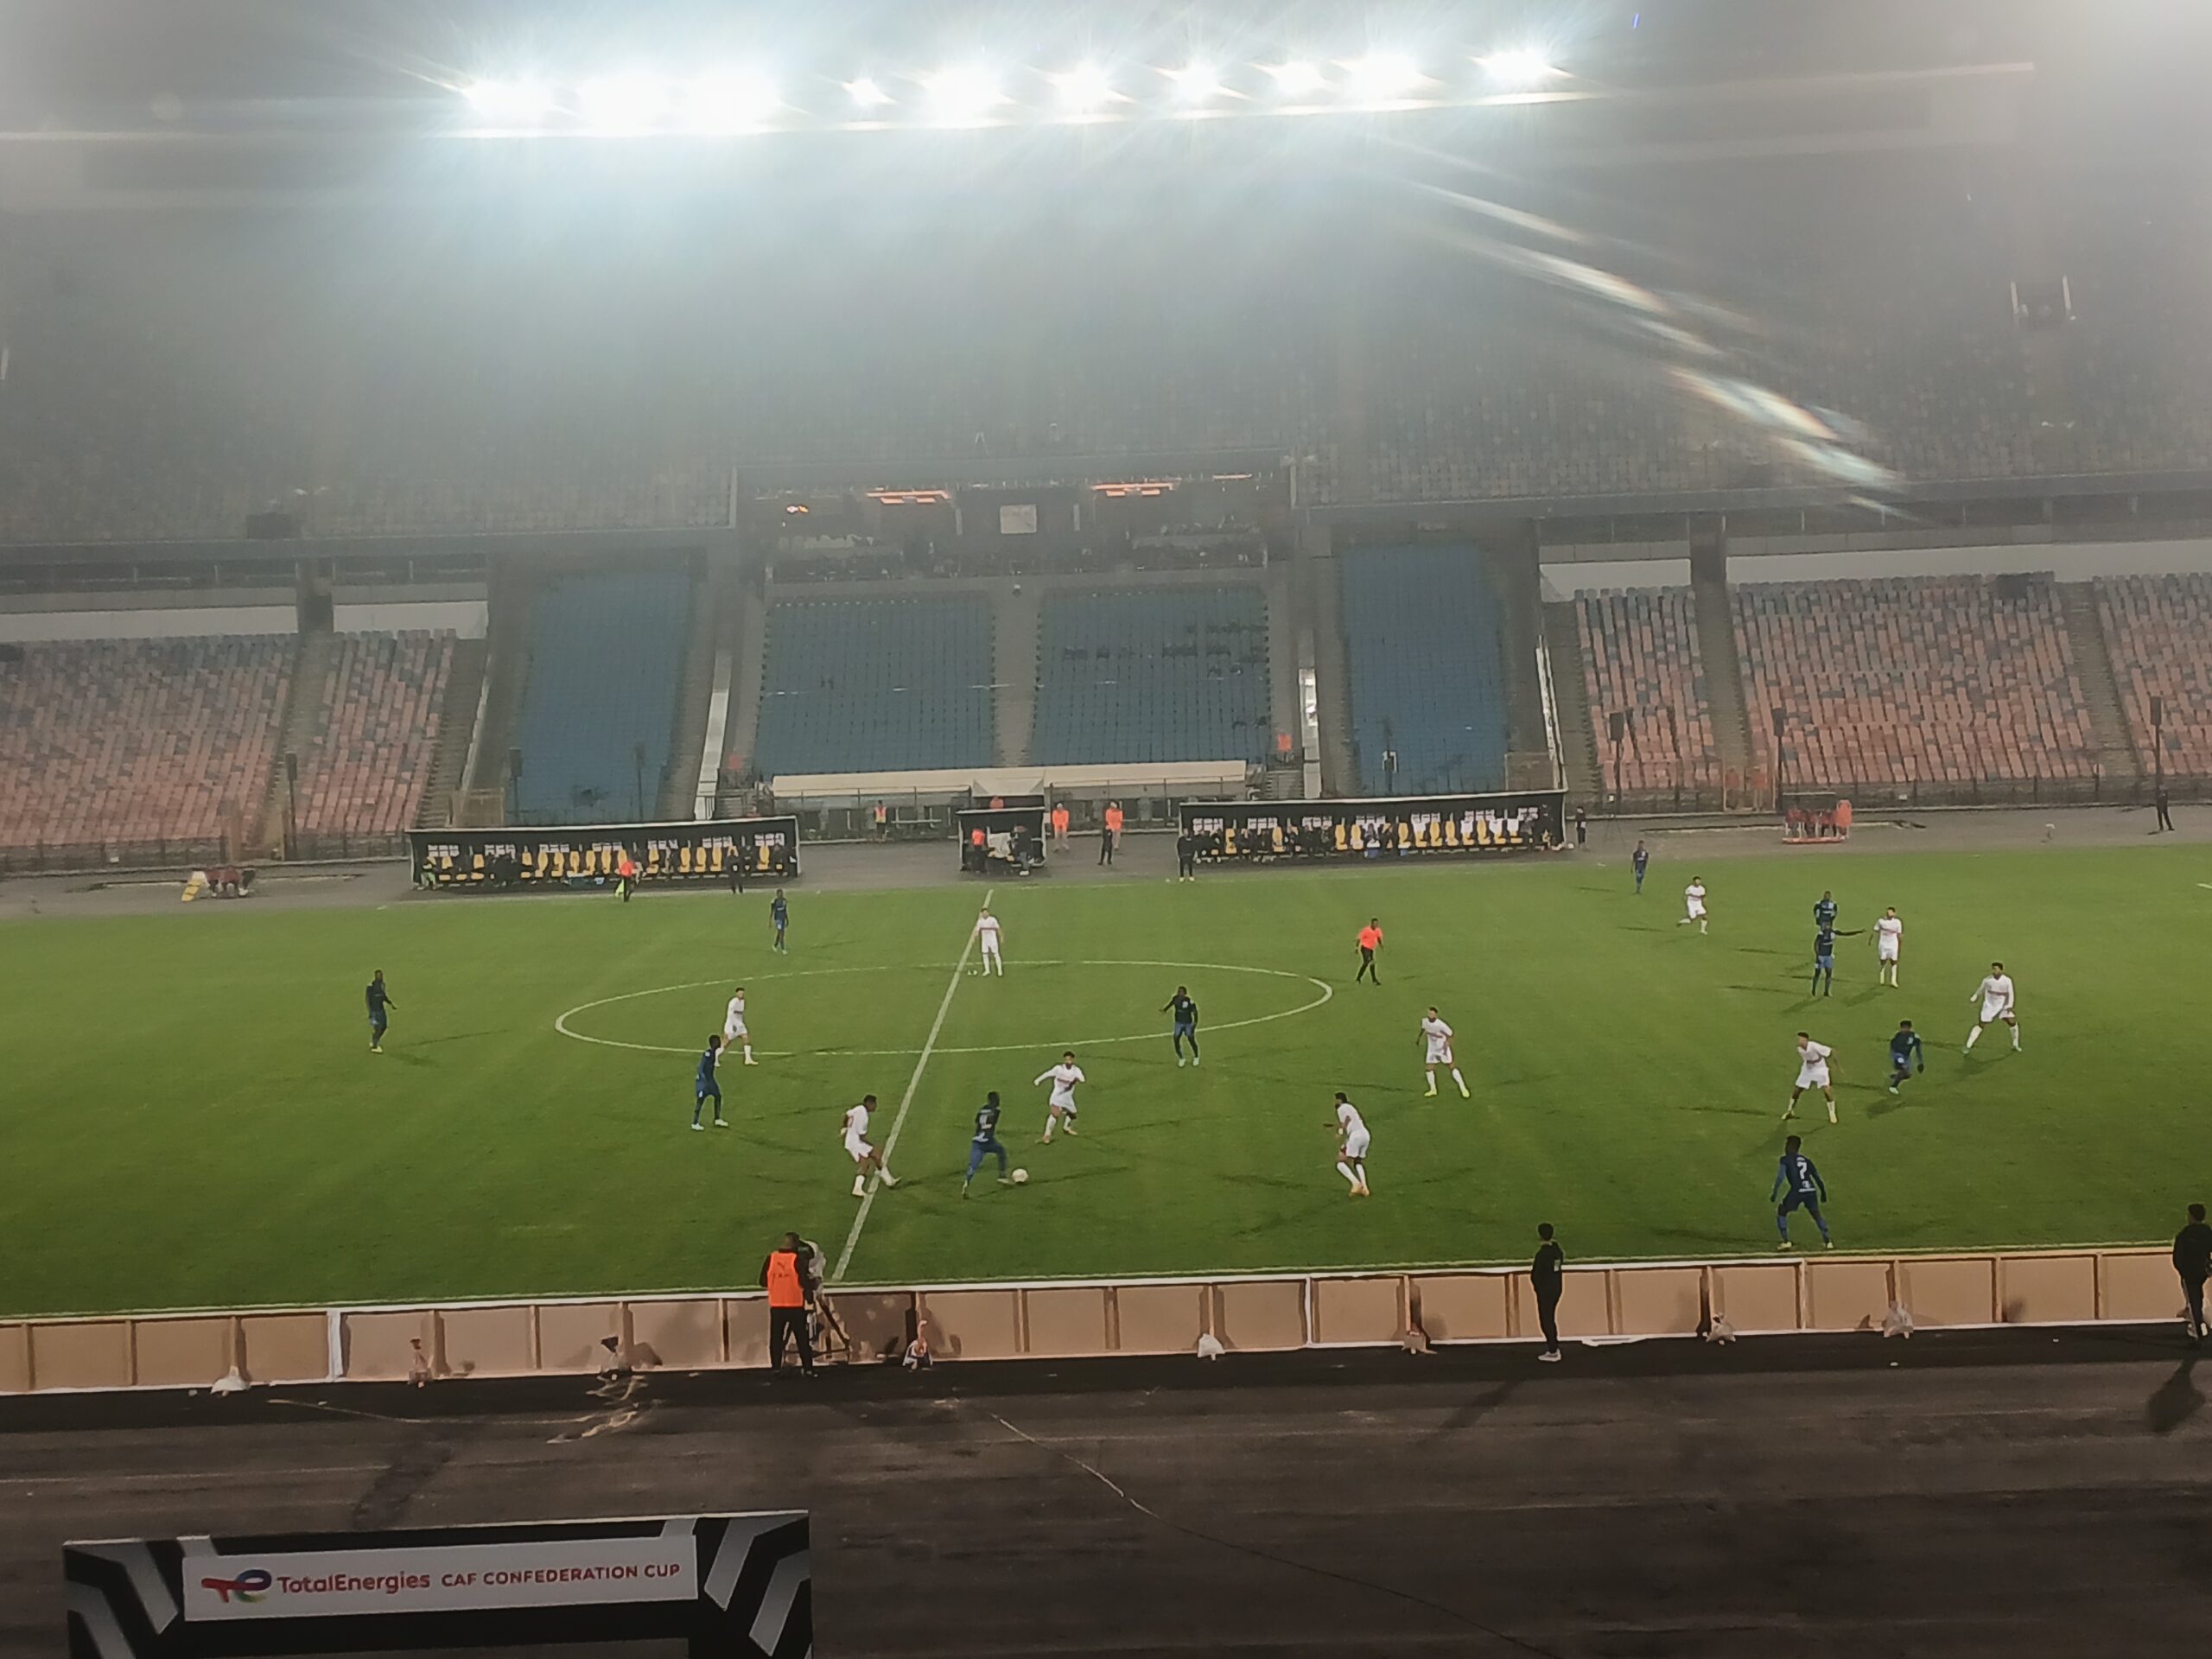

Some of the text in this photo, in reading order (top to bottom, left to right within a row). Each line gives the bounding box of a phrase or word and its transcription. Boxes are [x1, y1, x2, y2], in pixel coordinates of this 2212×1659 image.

[276, 1563, 681, 1595] TotalEnergies CAF CONFEDERATION CUP
